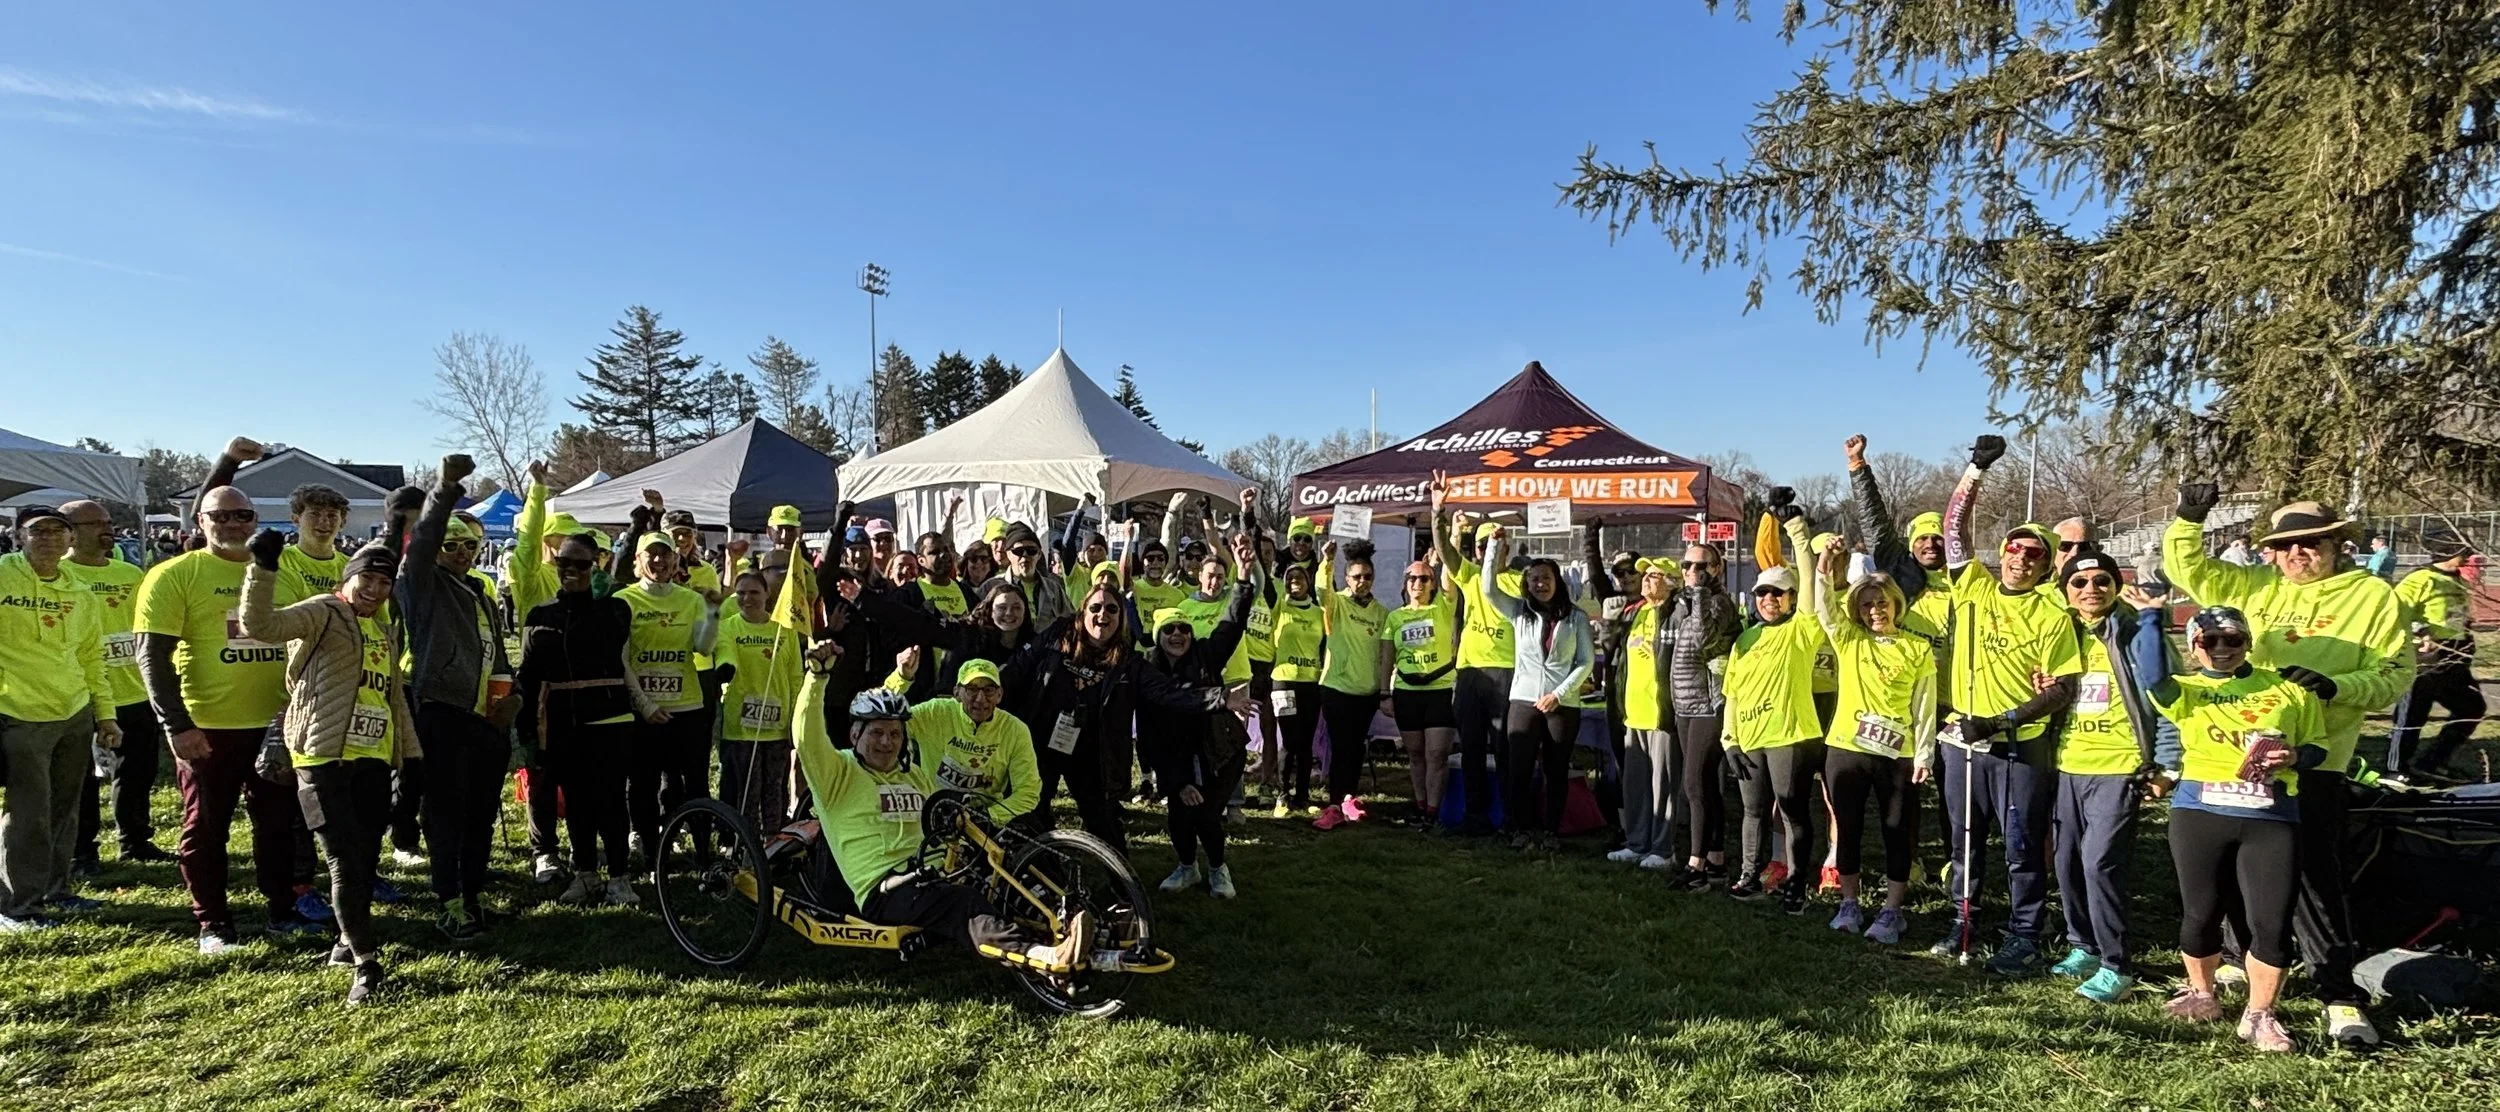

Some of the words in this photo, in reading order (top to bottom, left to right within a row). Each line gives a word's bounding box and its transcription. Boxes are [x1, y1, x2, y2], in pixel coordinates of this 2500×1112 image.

[1397, 428, 1543, 453] Achilles
[1534, 455, 1669, 468] Connecticut
[1300, 486, 1328, 505] Go
[1329, 481, 1430, 504] Achilles!
[1449, 478, 1491, 497] SEE
[1500, 477, 1563, 498] HOW
[1570, 478, 1612, 498] WE
[1620, 477, 1678, 498] RUN
[1405, 627, 1431, 640] 1321
[220, 648, 285, 663] GUIDE
[637, 650, 687, 663] GUIDE
[1406, 653, 1438, 664] GUIDE
[643, 677, 679, 692] 1323
[745, 703, 779, 722] 2098
[347, 714, 385, 739] 1305
[948, 736, 985, 754] Achilles
[1862, 723, 1902, 749] 1317
[941, 765, 978, 788] 2170
